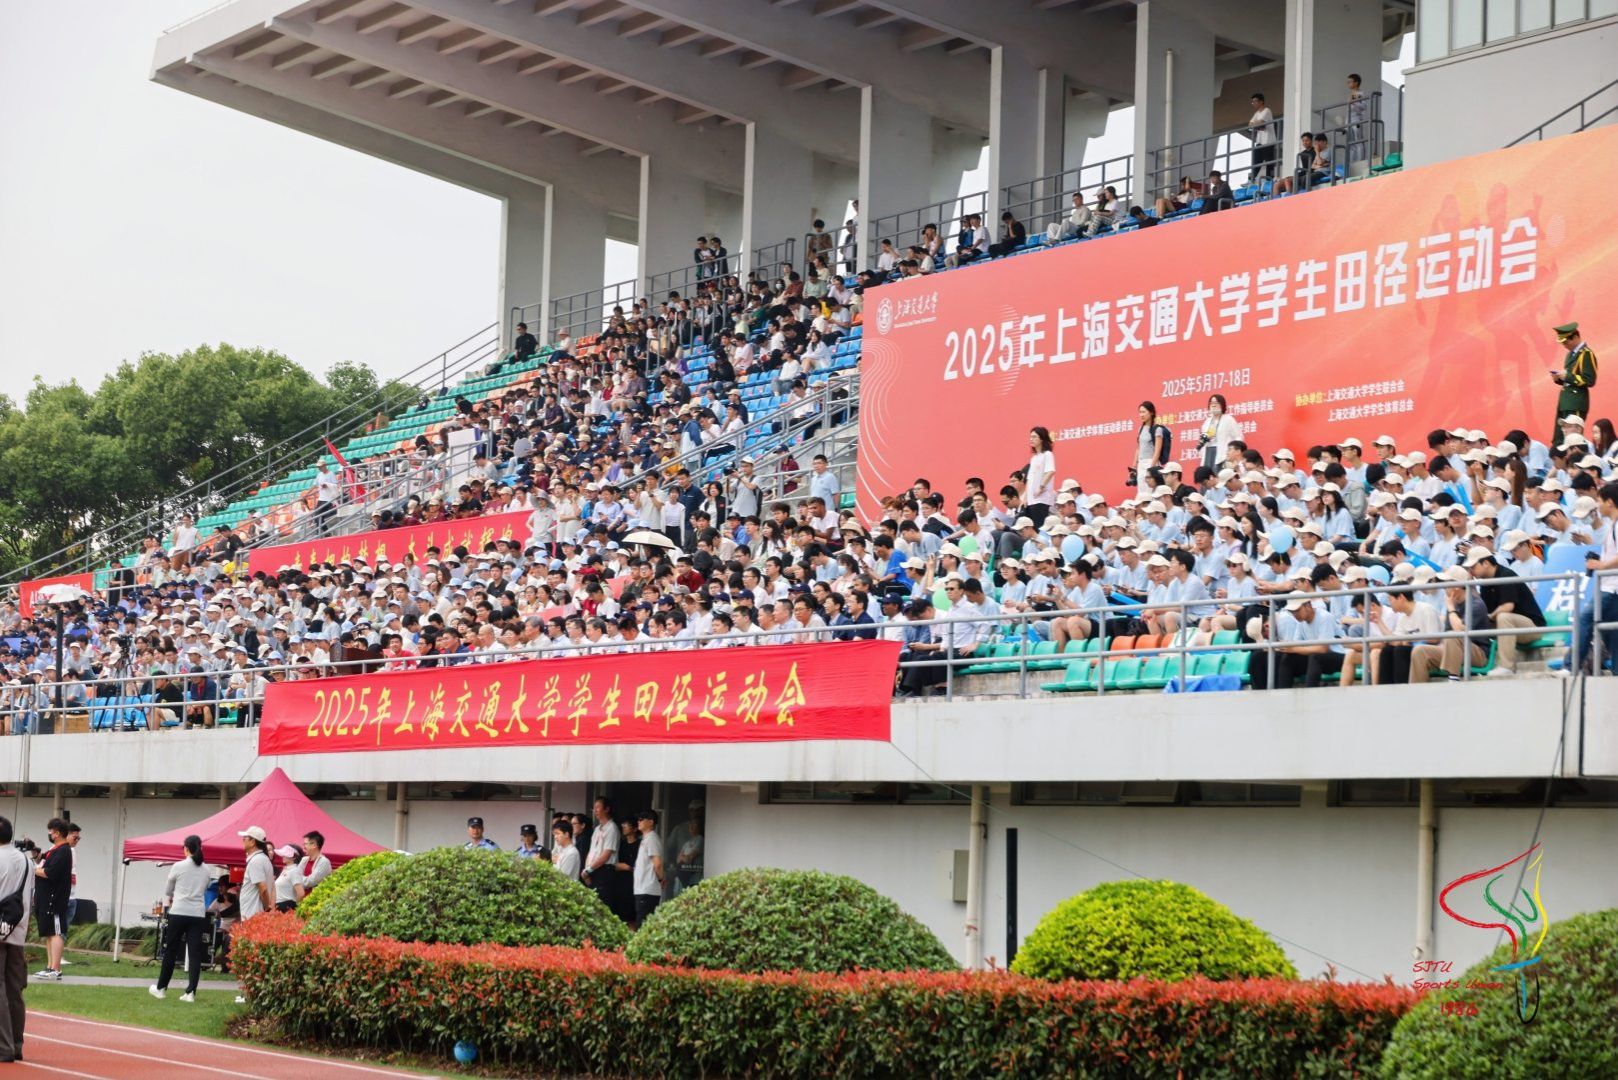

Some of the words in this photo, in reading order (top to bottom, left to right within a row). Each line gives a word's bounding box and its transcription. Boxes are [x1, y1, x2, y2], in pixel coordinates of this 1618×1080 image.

[943, 216, 1538, 381] 2025年上海交通大学学生田径运动会
[1162, 368, 1251, 398] 2025年5月17-18日
[307, 661, 807, 745] 2025年上海交通大学学生田径运动会
